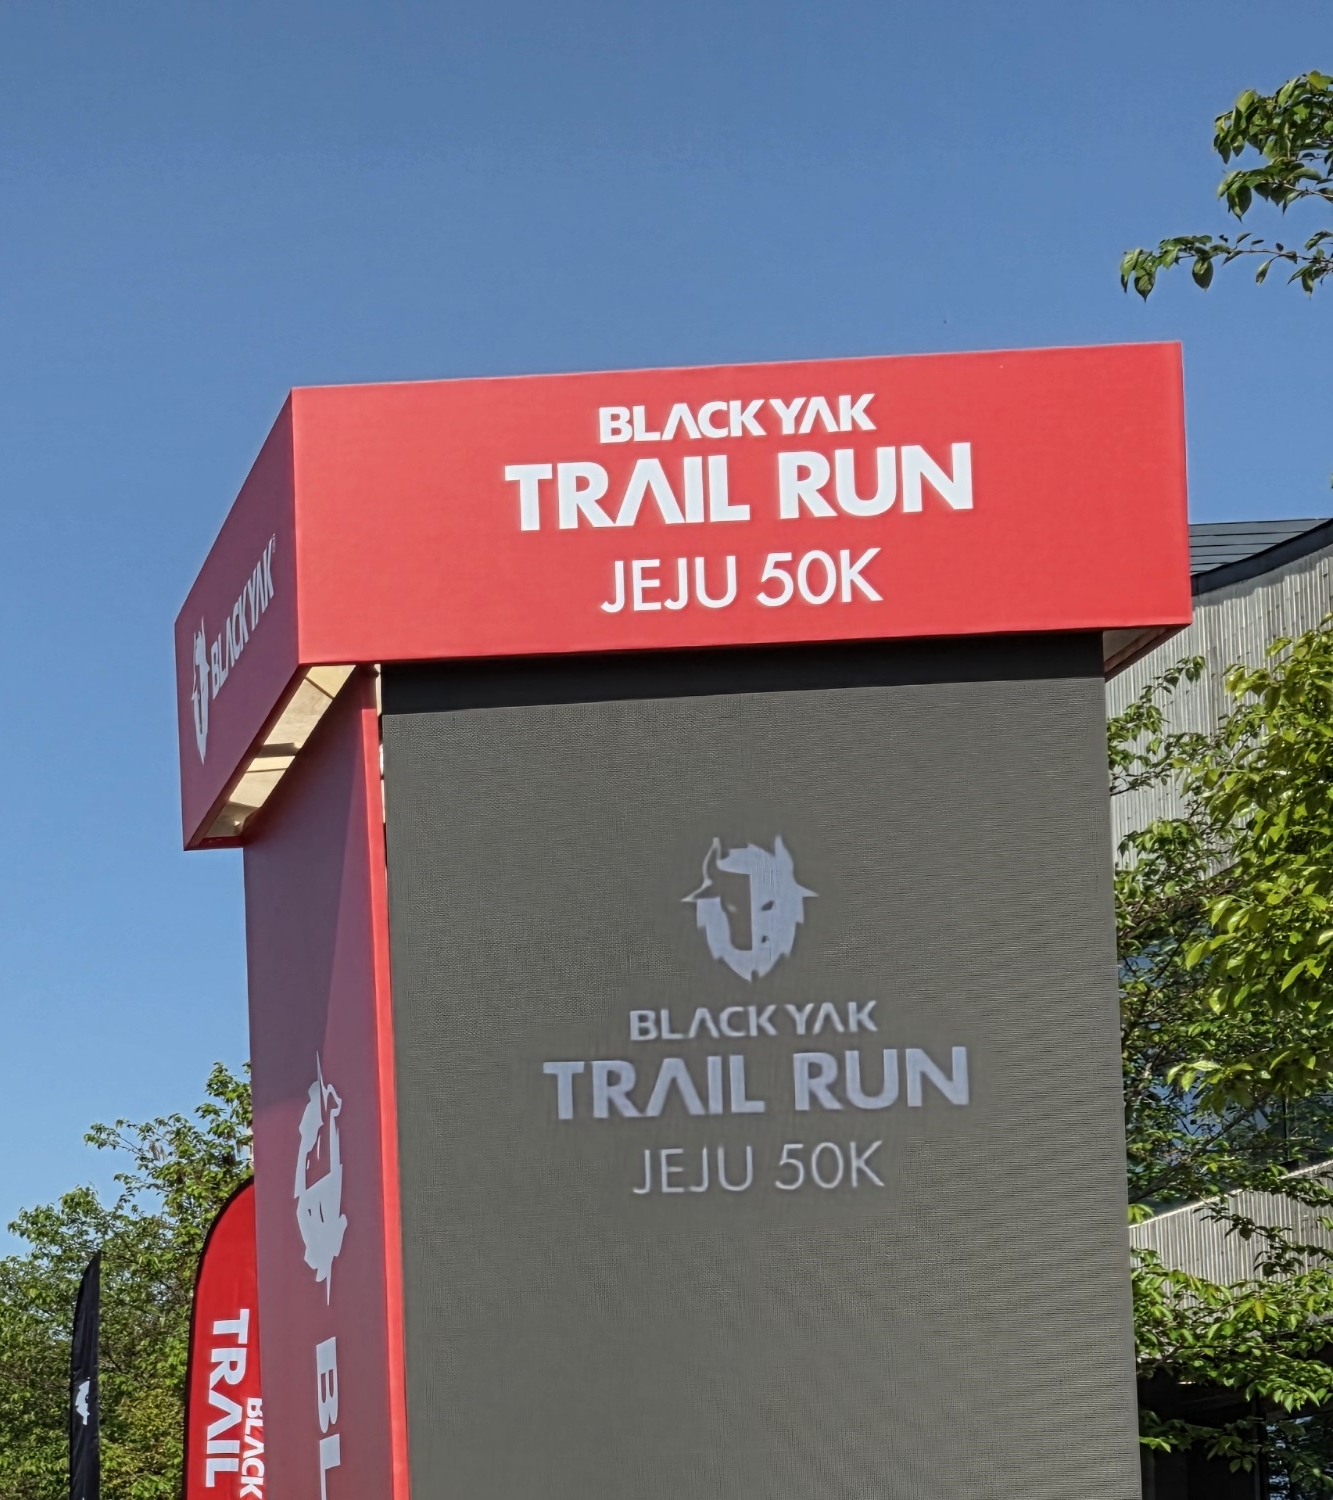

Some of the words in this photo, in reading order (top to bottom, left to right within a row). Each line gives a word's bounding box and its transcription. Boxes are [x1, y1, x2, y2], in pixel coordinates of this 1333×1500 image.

[505, 455, 751, 531] TRAIL
[778, 442, 974, 519] RUN
[600, 555, 737, 613] JEJU
[756, 547, 884, 607] 50K
[542, 1054, 765, 1120] TRAIL
[792, 1046, 969, 1111] RUN
[632, 1145, 753, 1195] JEJU
[775, 1140, 885, 1190] 50K
[205, 1308, 250, 1488] TRAIL
